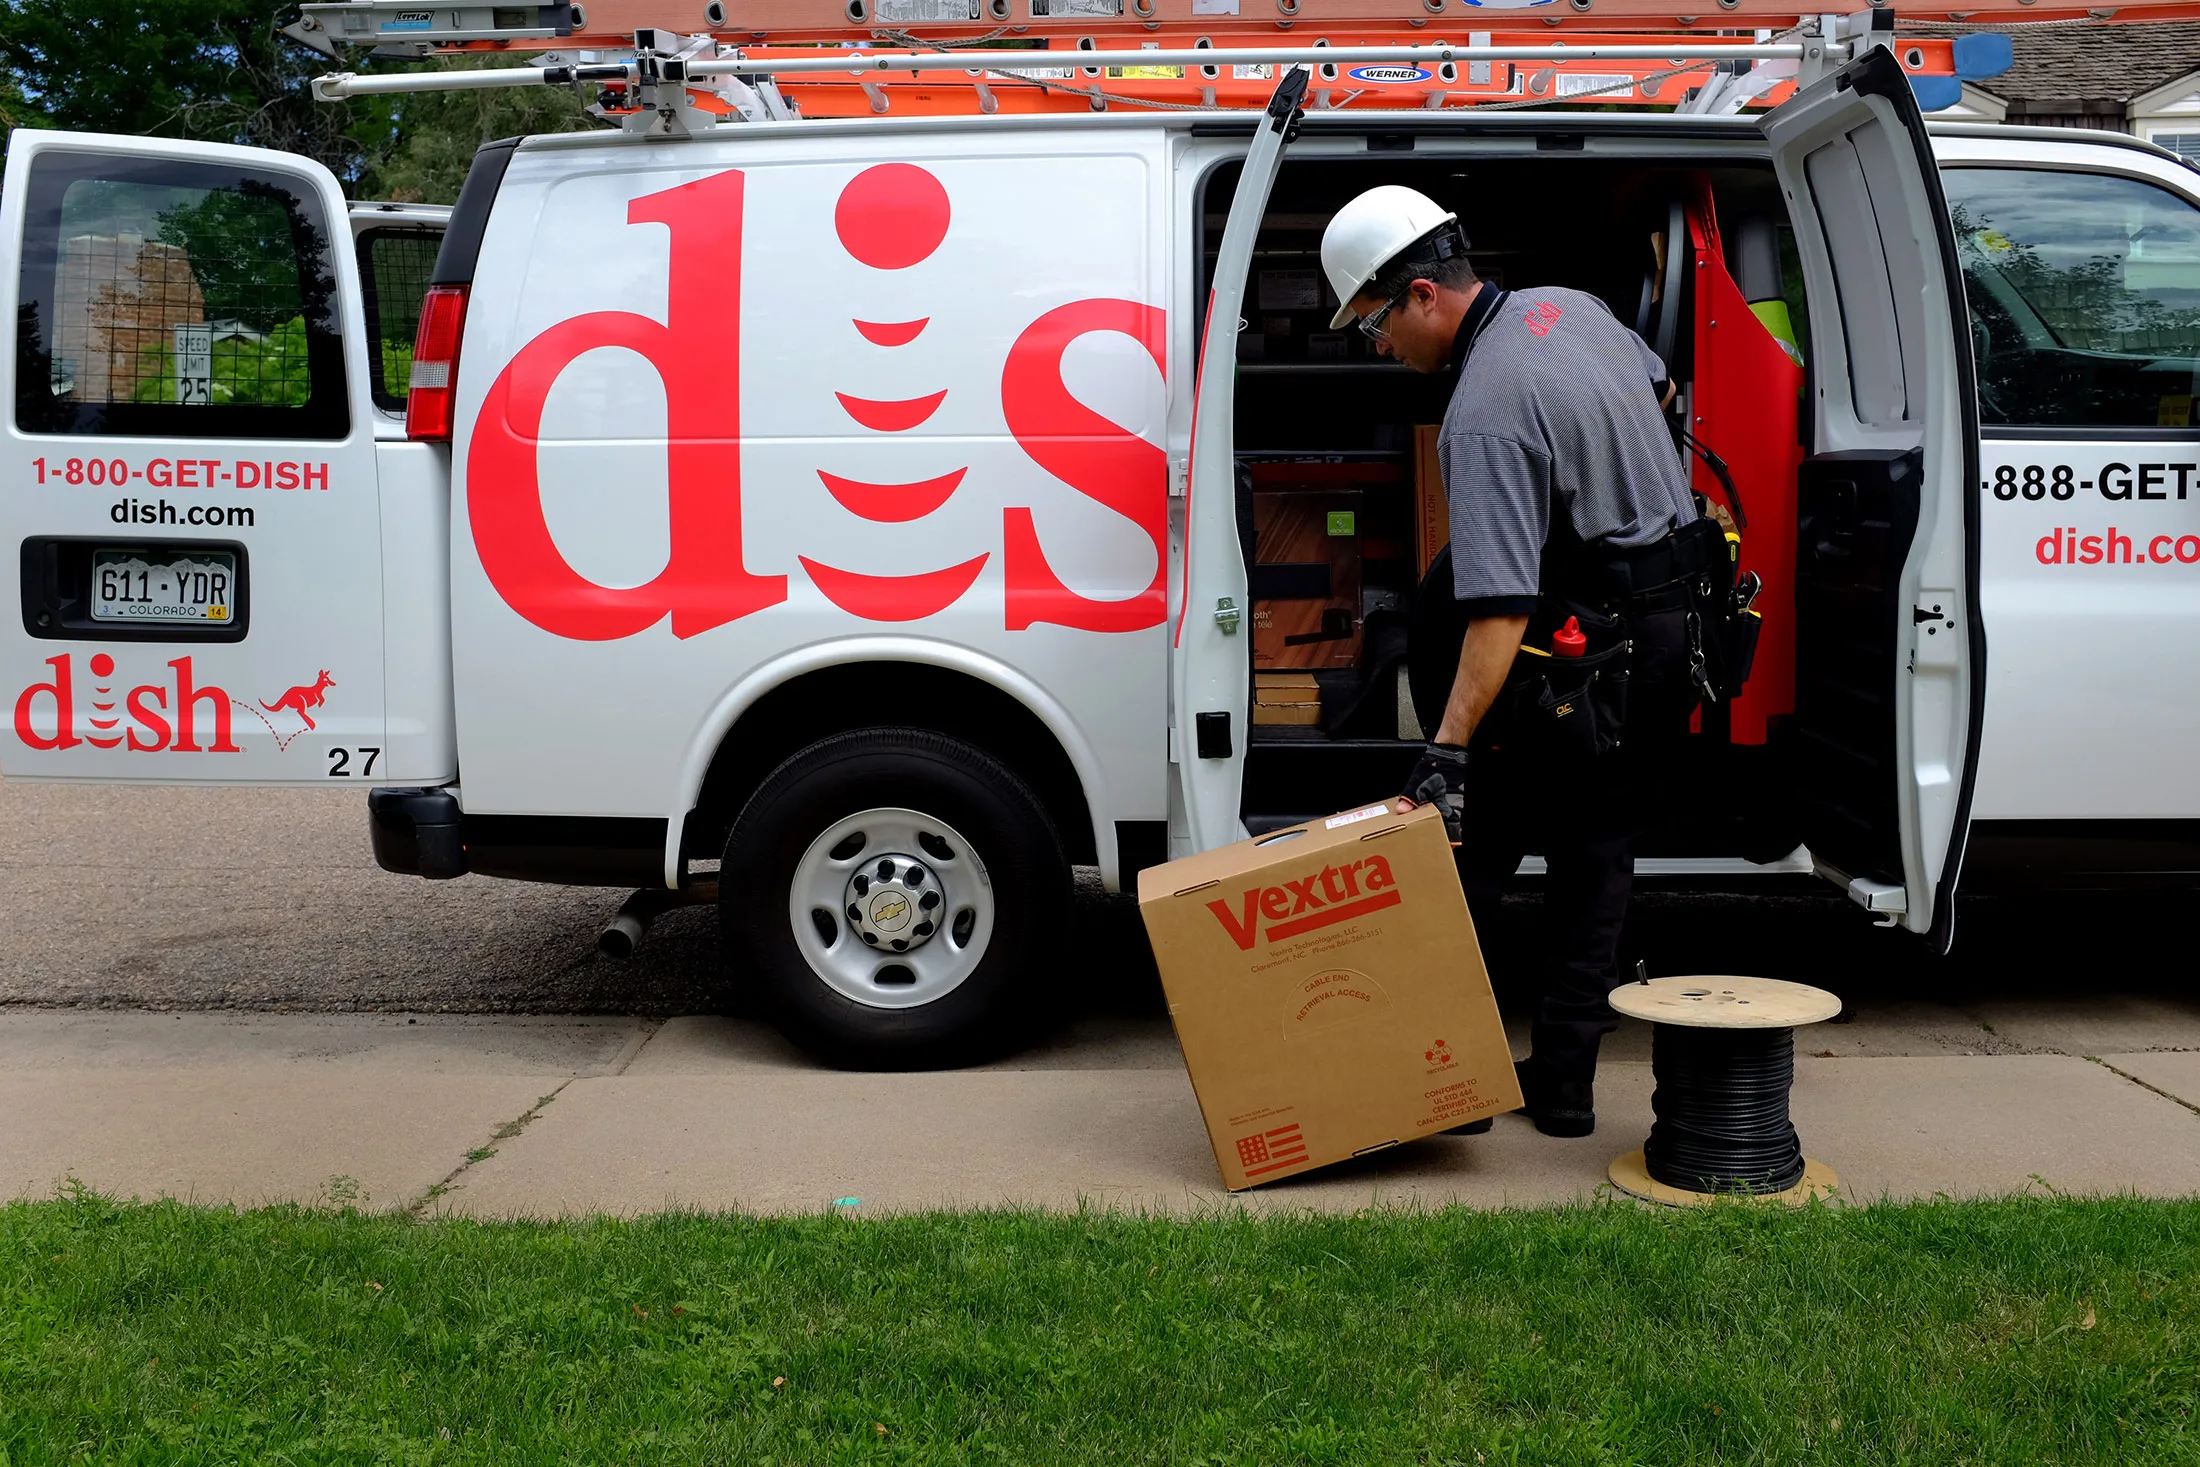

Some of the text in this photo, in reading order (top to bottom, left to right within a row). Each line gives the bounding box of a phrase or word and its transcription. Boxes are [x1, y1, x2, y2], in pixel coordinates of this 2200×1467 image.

[1366, 70, 1417, 78] WERNER
[1523, 301, 1563, 337] dish
[178, 337, 208, 352] SPEED
[182, 357, 205, 372] LIMIT
[181, 377, 209, 405] 25
[466, 162, 1167, 642] dis
[32, 457, 329, 491] 1-800-GET-DISH
[1982, 462, 2200, 501] -888-GET
[111, 498, 255, 527] dish.com
[1427, 494, 1436, 515] NOT
[1428, 526, 1437, 560] HANDL
[2036, 527, 2200, 565] dish.co
[101, 568, 227, 605] 611 YDR
[128, 605, 197, 616] COLORADO
[210, 608, 221, 616] 14
[14, 653, 241, 753] dish
[328, 747, 382, 778] 27
[1205, 854, 1396, 952] Vextra
[1269, 947, 1293, 958] Vextra
[1344, 925, 1359, 937] LLC
[1293, 951, 1306, 961] NC
[1312, 943, 1336, 955] Phone
[1304, 974, 1350, 993] CABLE END
[1296, 988, 1372, 1021] RETRIEVAL ACCESS
[1426, 1062, 1459, 1075] RECYCLABLE
[1424, 1078, 1477, 1099] CONFORMS TO
[1433, 1088, 1473, 1105] UL STD 444
[1416, 1113, 1450, 1127] CAN/CSA
[1450, 1106, 1472, 1117] C22.2
[1432, 1095, 1479, 1114] CERTIFIED TO
